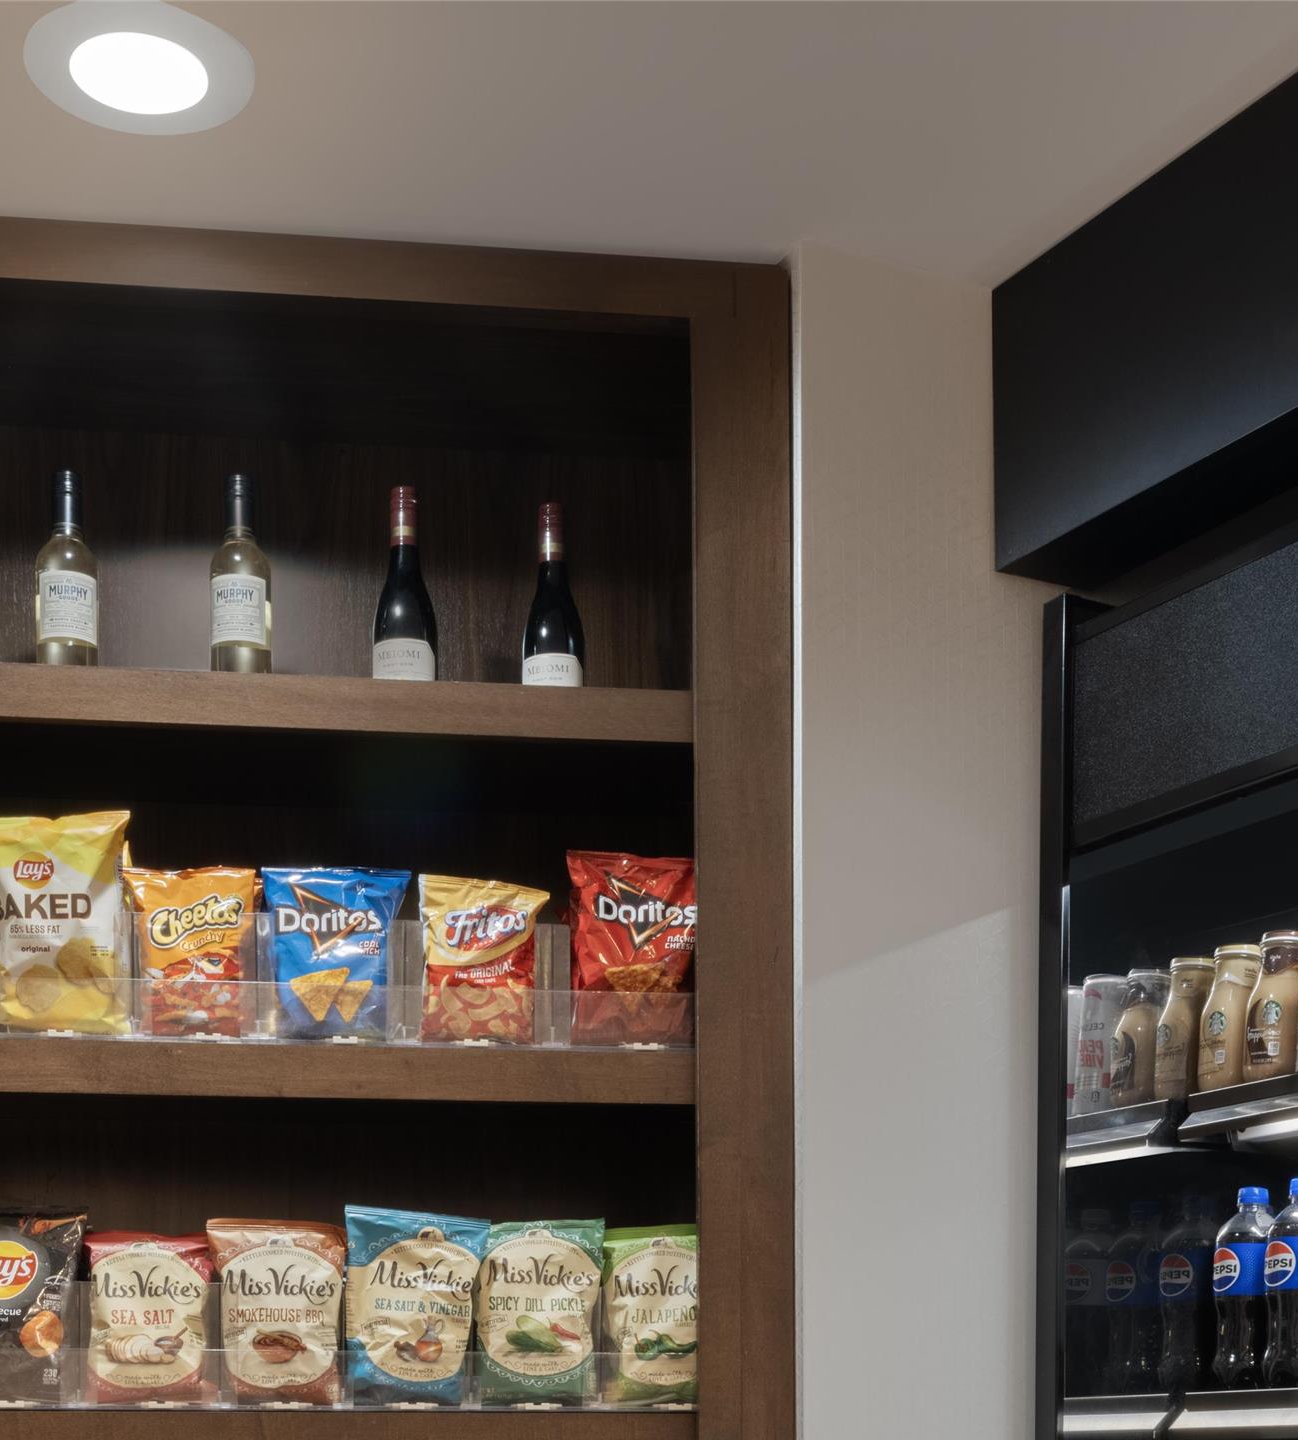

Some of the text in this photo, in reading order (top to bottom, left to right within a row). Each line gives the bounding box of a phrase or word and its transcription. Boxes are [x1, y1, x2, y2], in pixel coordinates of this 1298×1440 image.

[48, 585, 88, 600] MURPHY
[216, 588, 254, 603] MURPHY
[15, 858, 53, 880] Lay's
[151, 895, 243, 946] Cheetos
[277, 907, 382, 933] Doritos
[598, 895, 697, 926] Doritos
[25, 924, 46, 934] LESS
[47, 924, 60, 934] FAT
[446, 907, 528, 947] Fritos
[21, 944, 51, 954] original
[180, 930, 224, 952] Crunchy
[667, 935, 696, 944] NACHO
[470, 960, 515, 979] ORIGINAL
[92, 1264, 202, 1306] Miss Vickie's
[221, 1264, 338, 1306] Miss Vickie's
[369, 1260, 418, 1290] Miss
[487, 1253, 595, 1296] Miss Vickie's
[612, 1272, 658, 1302] Miss
[374, 1297, 393, 1311] SEA
[394, 1298, 416, 1313] SALT
[418, 1300, 427, 1314] &
[488, 1296, 586, 1313] SPICY DILL PICKLE
[111, 1308, 175, 1326] SEA SALT
[229, 1308, 325, 1326] SMOKEHOUSE BBQ
